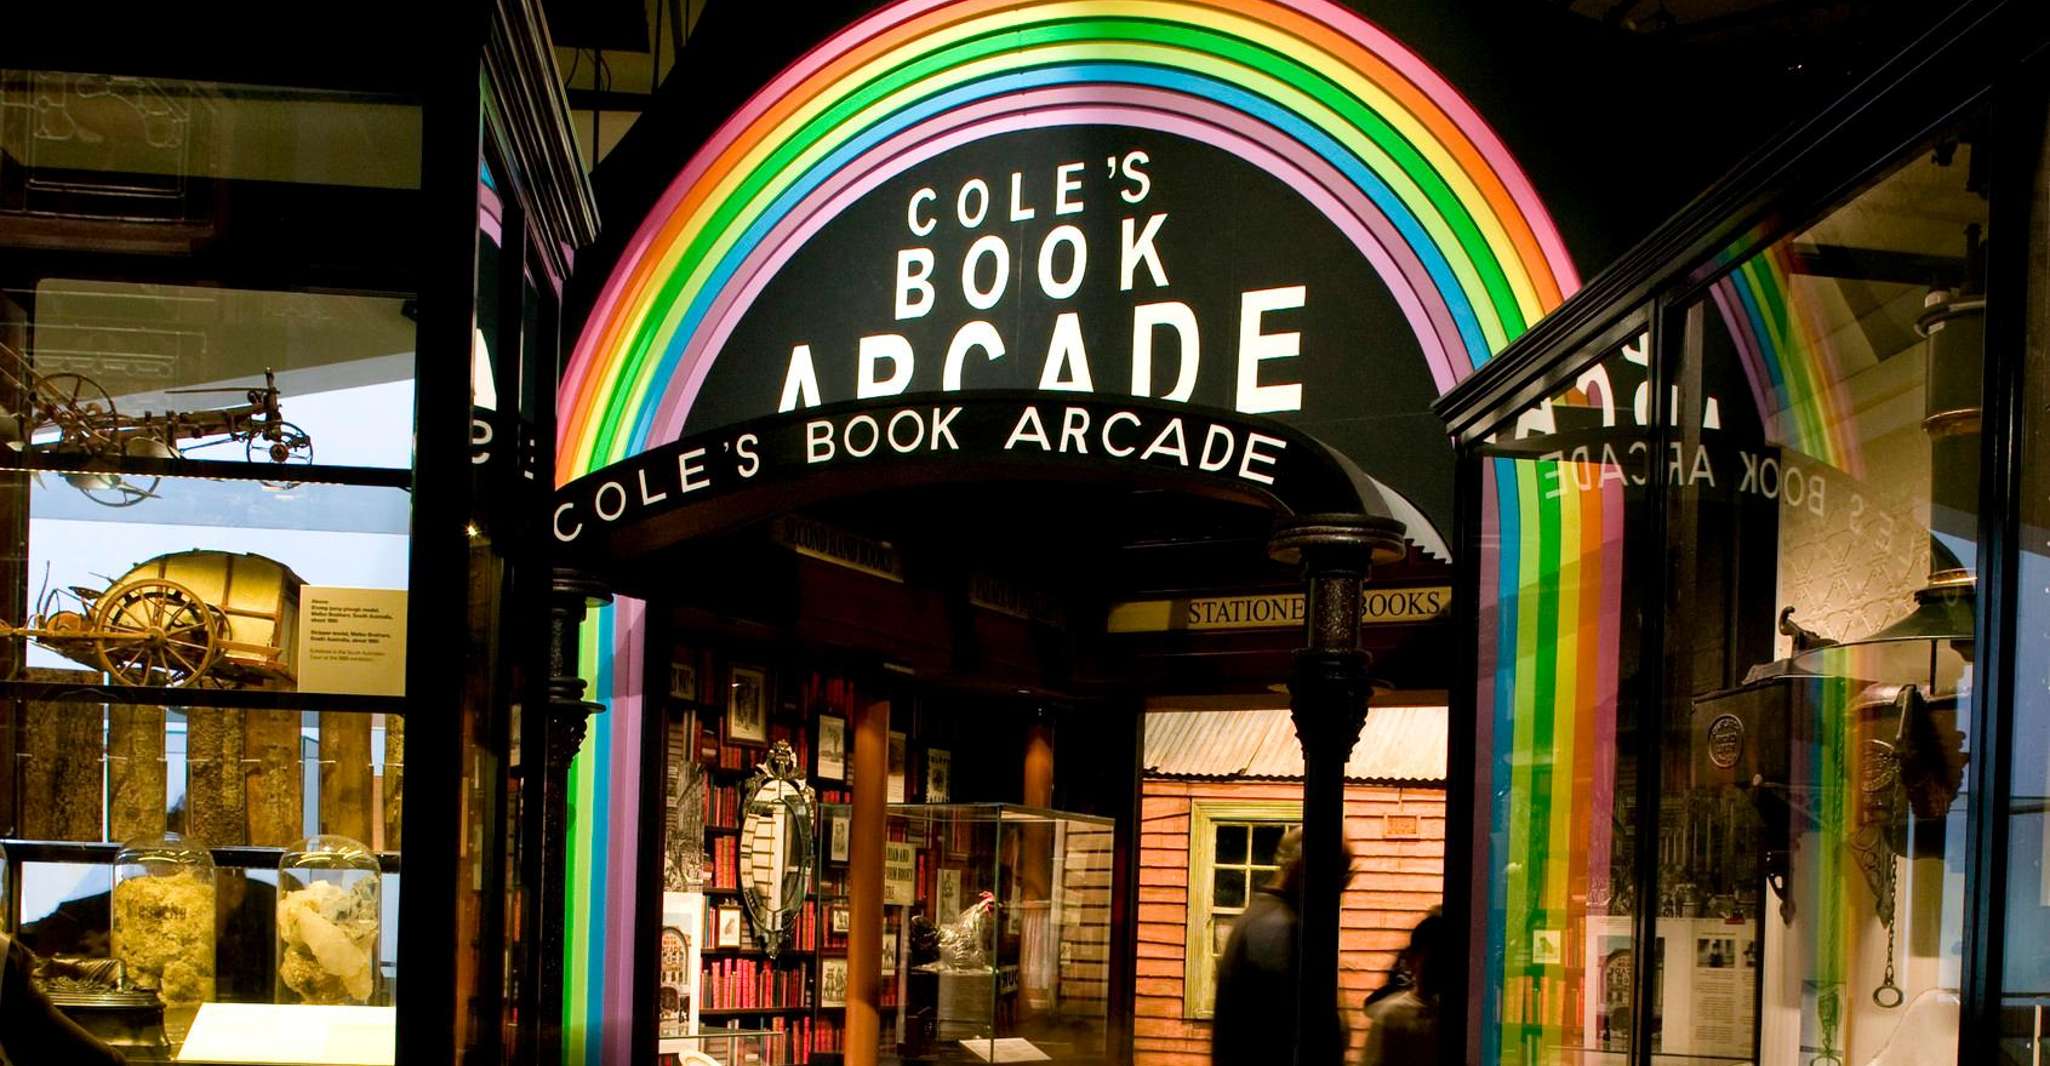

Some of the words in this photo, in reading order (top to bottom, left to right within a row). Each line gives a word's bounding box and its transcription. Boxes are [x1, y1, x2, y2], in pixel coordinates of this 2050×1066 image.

[908, 151, 1151, 237] COLE'S
[895, 213, 1170, 320] BOOK
[778, 285, 1307, 415] ARCADE
[553, 434, 760, 542] COLE'S
[806, 406, 964, 464] BOOK
[1003, 406, 1288, 485] ARCADE
[1188, 597, 1305, 625] STATIONE
